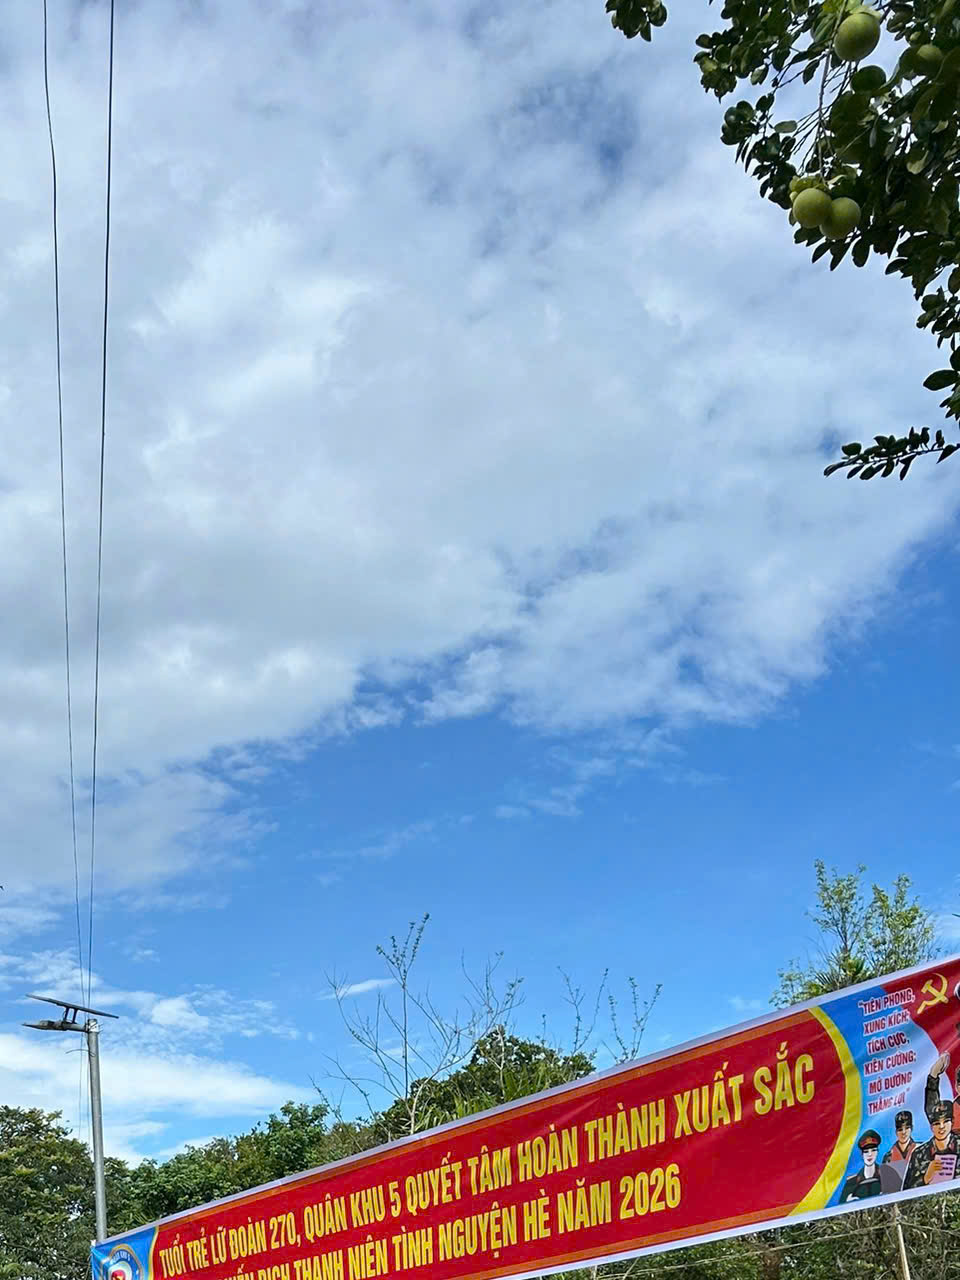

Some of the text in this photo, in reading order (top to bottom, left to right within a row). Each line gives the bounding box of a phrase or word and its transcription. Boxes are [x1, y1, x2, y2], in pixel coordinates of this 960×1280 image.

[864, 1018, 886, 1035] XUNG
[864, 1058, 884, 1075] KIÊN
[159, 1041, 816, 1279] TUỔI TRẺ LỮ ĐOÀN 270, QUÂN KHU 5 QUYẾT TÂM HOÀN THÀNH XUẤT SẮC
[391, 1225, 434, 1272] TÌNH
[438, 1201, 518, 1262] NGUYỆN
[523, 1188, 551, 1242] HÈ
[557, 1177, 613, 1234] NĂM
[619, 1162, 682, 1220] 2026
